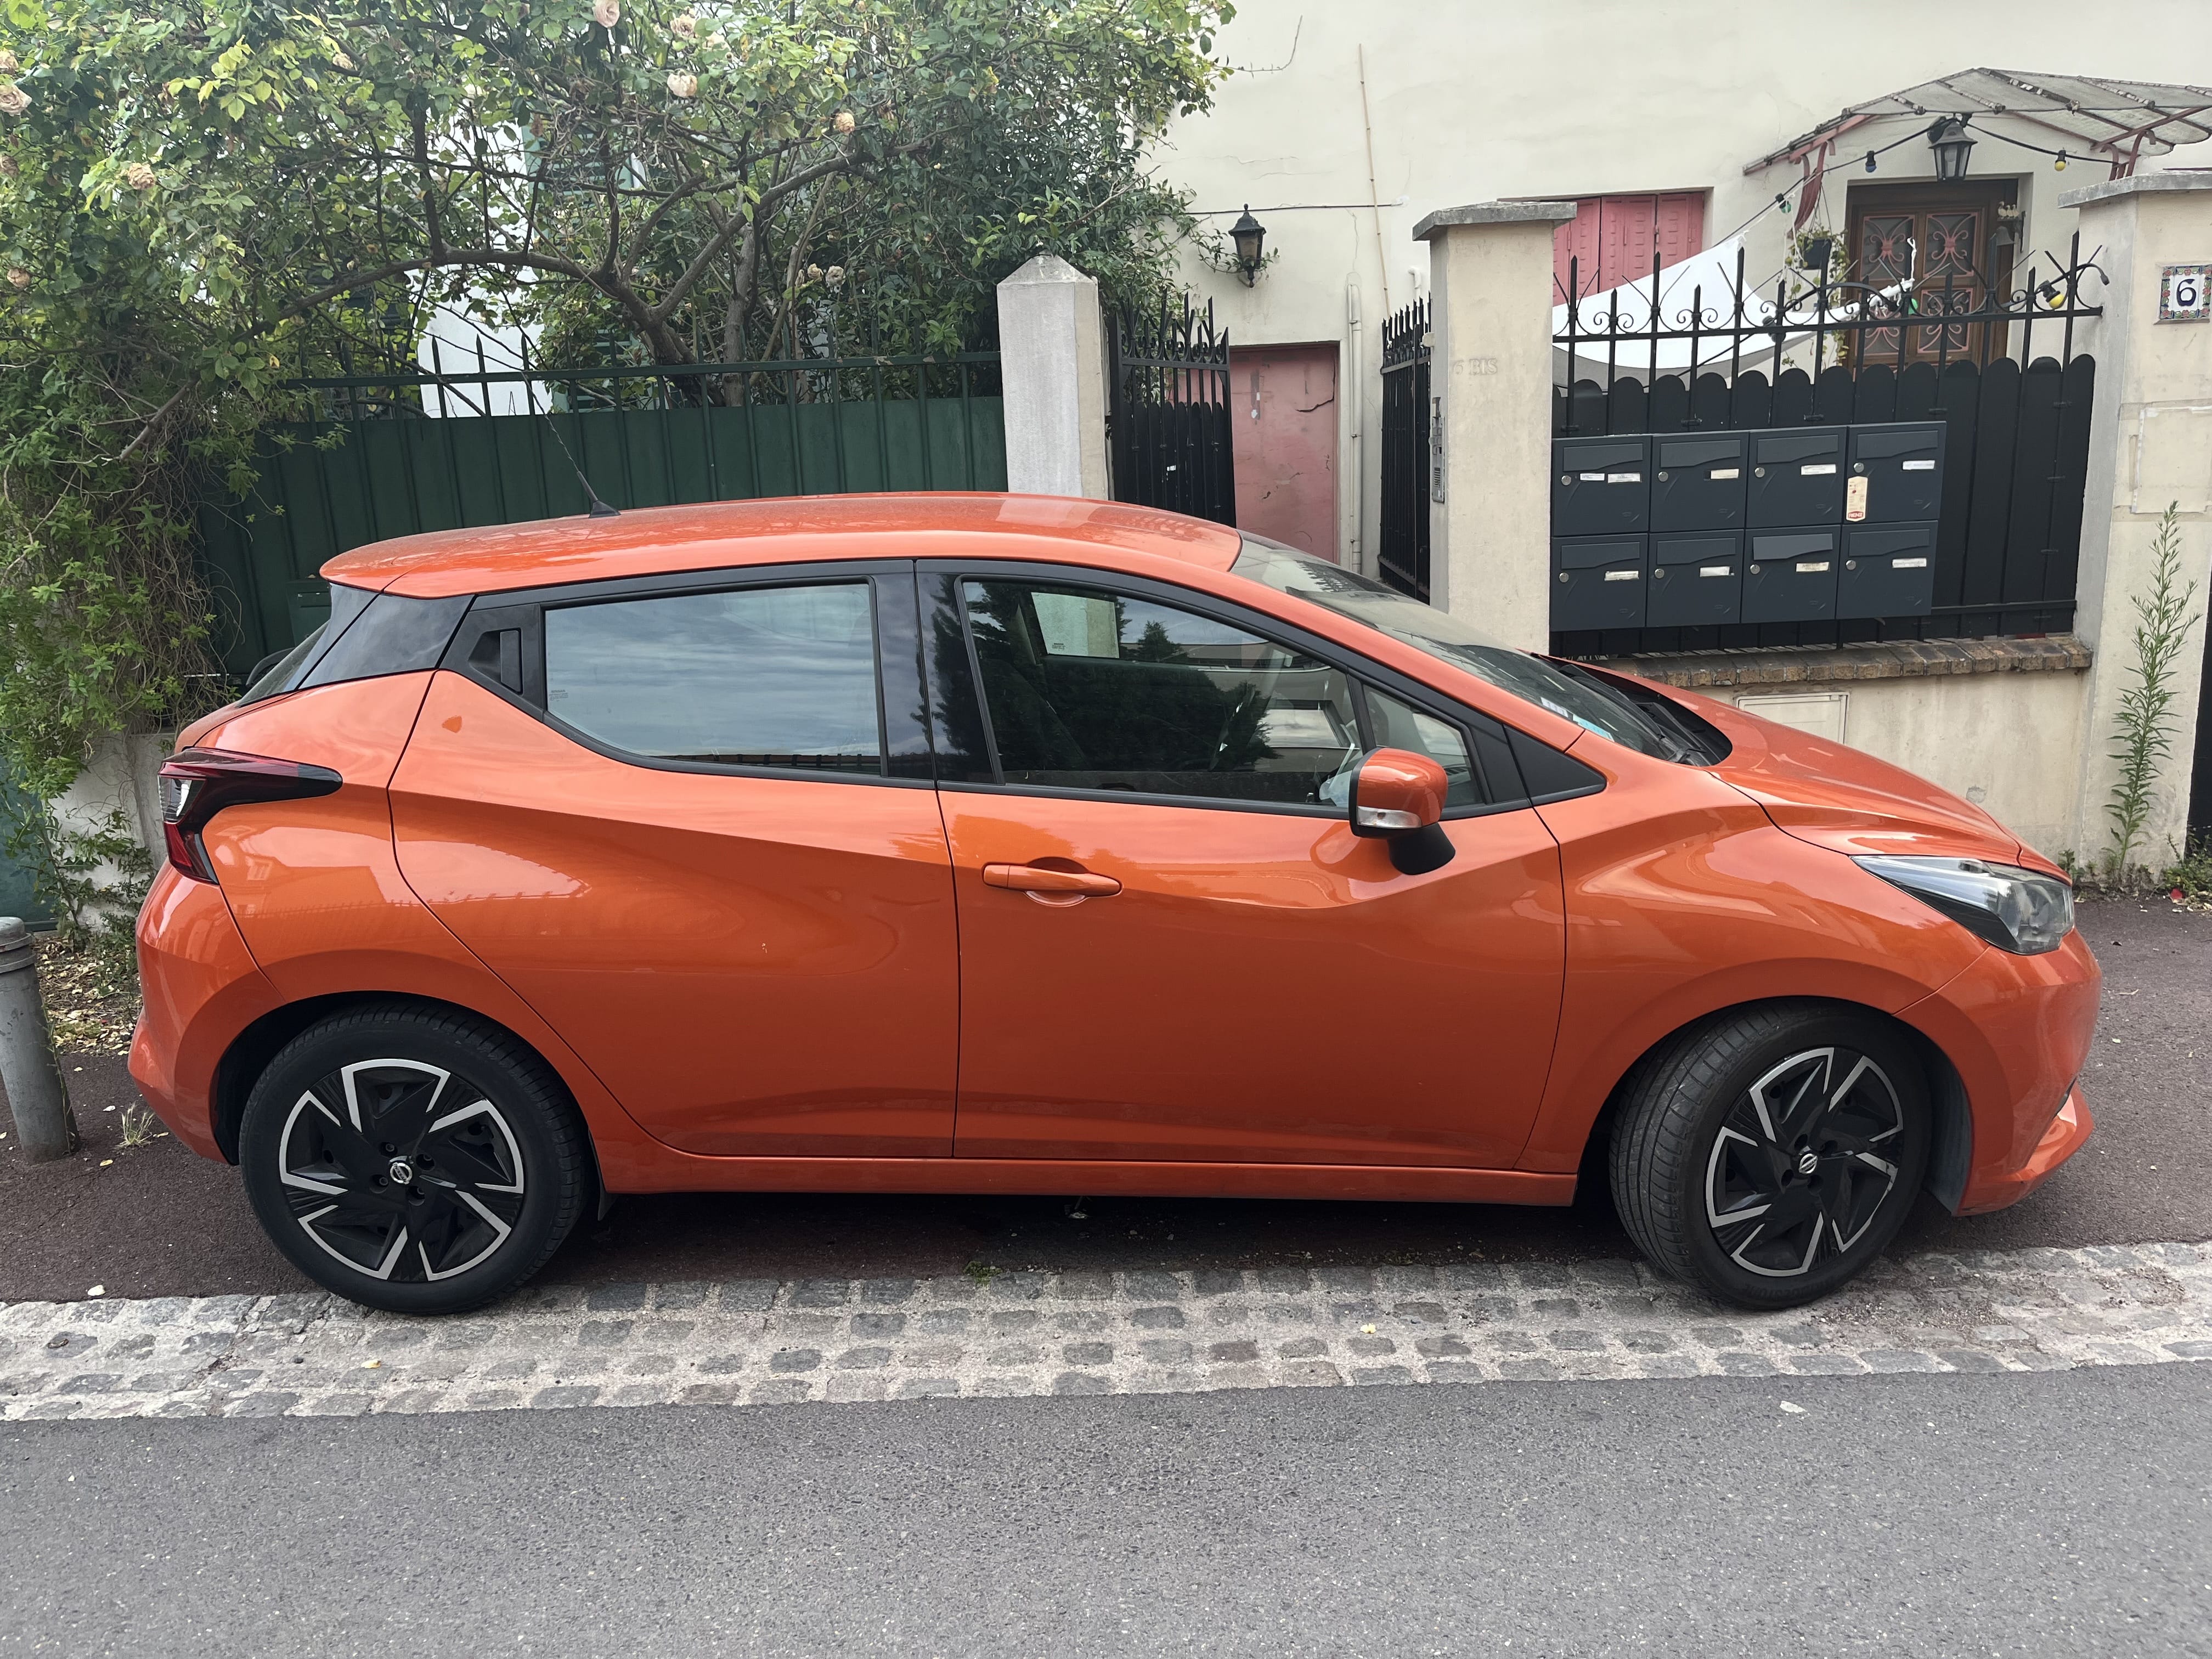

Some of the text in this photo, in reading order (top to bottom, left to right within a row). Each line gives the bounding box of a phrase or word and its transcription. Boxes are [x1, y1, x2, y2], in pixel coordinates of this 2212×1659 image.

[2176, 279, 2197, 307] 6
[1453, 358, 1497, 375] 6 BIS
